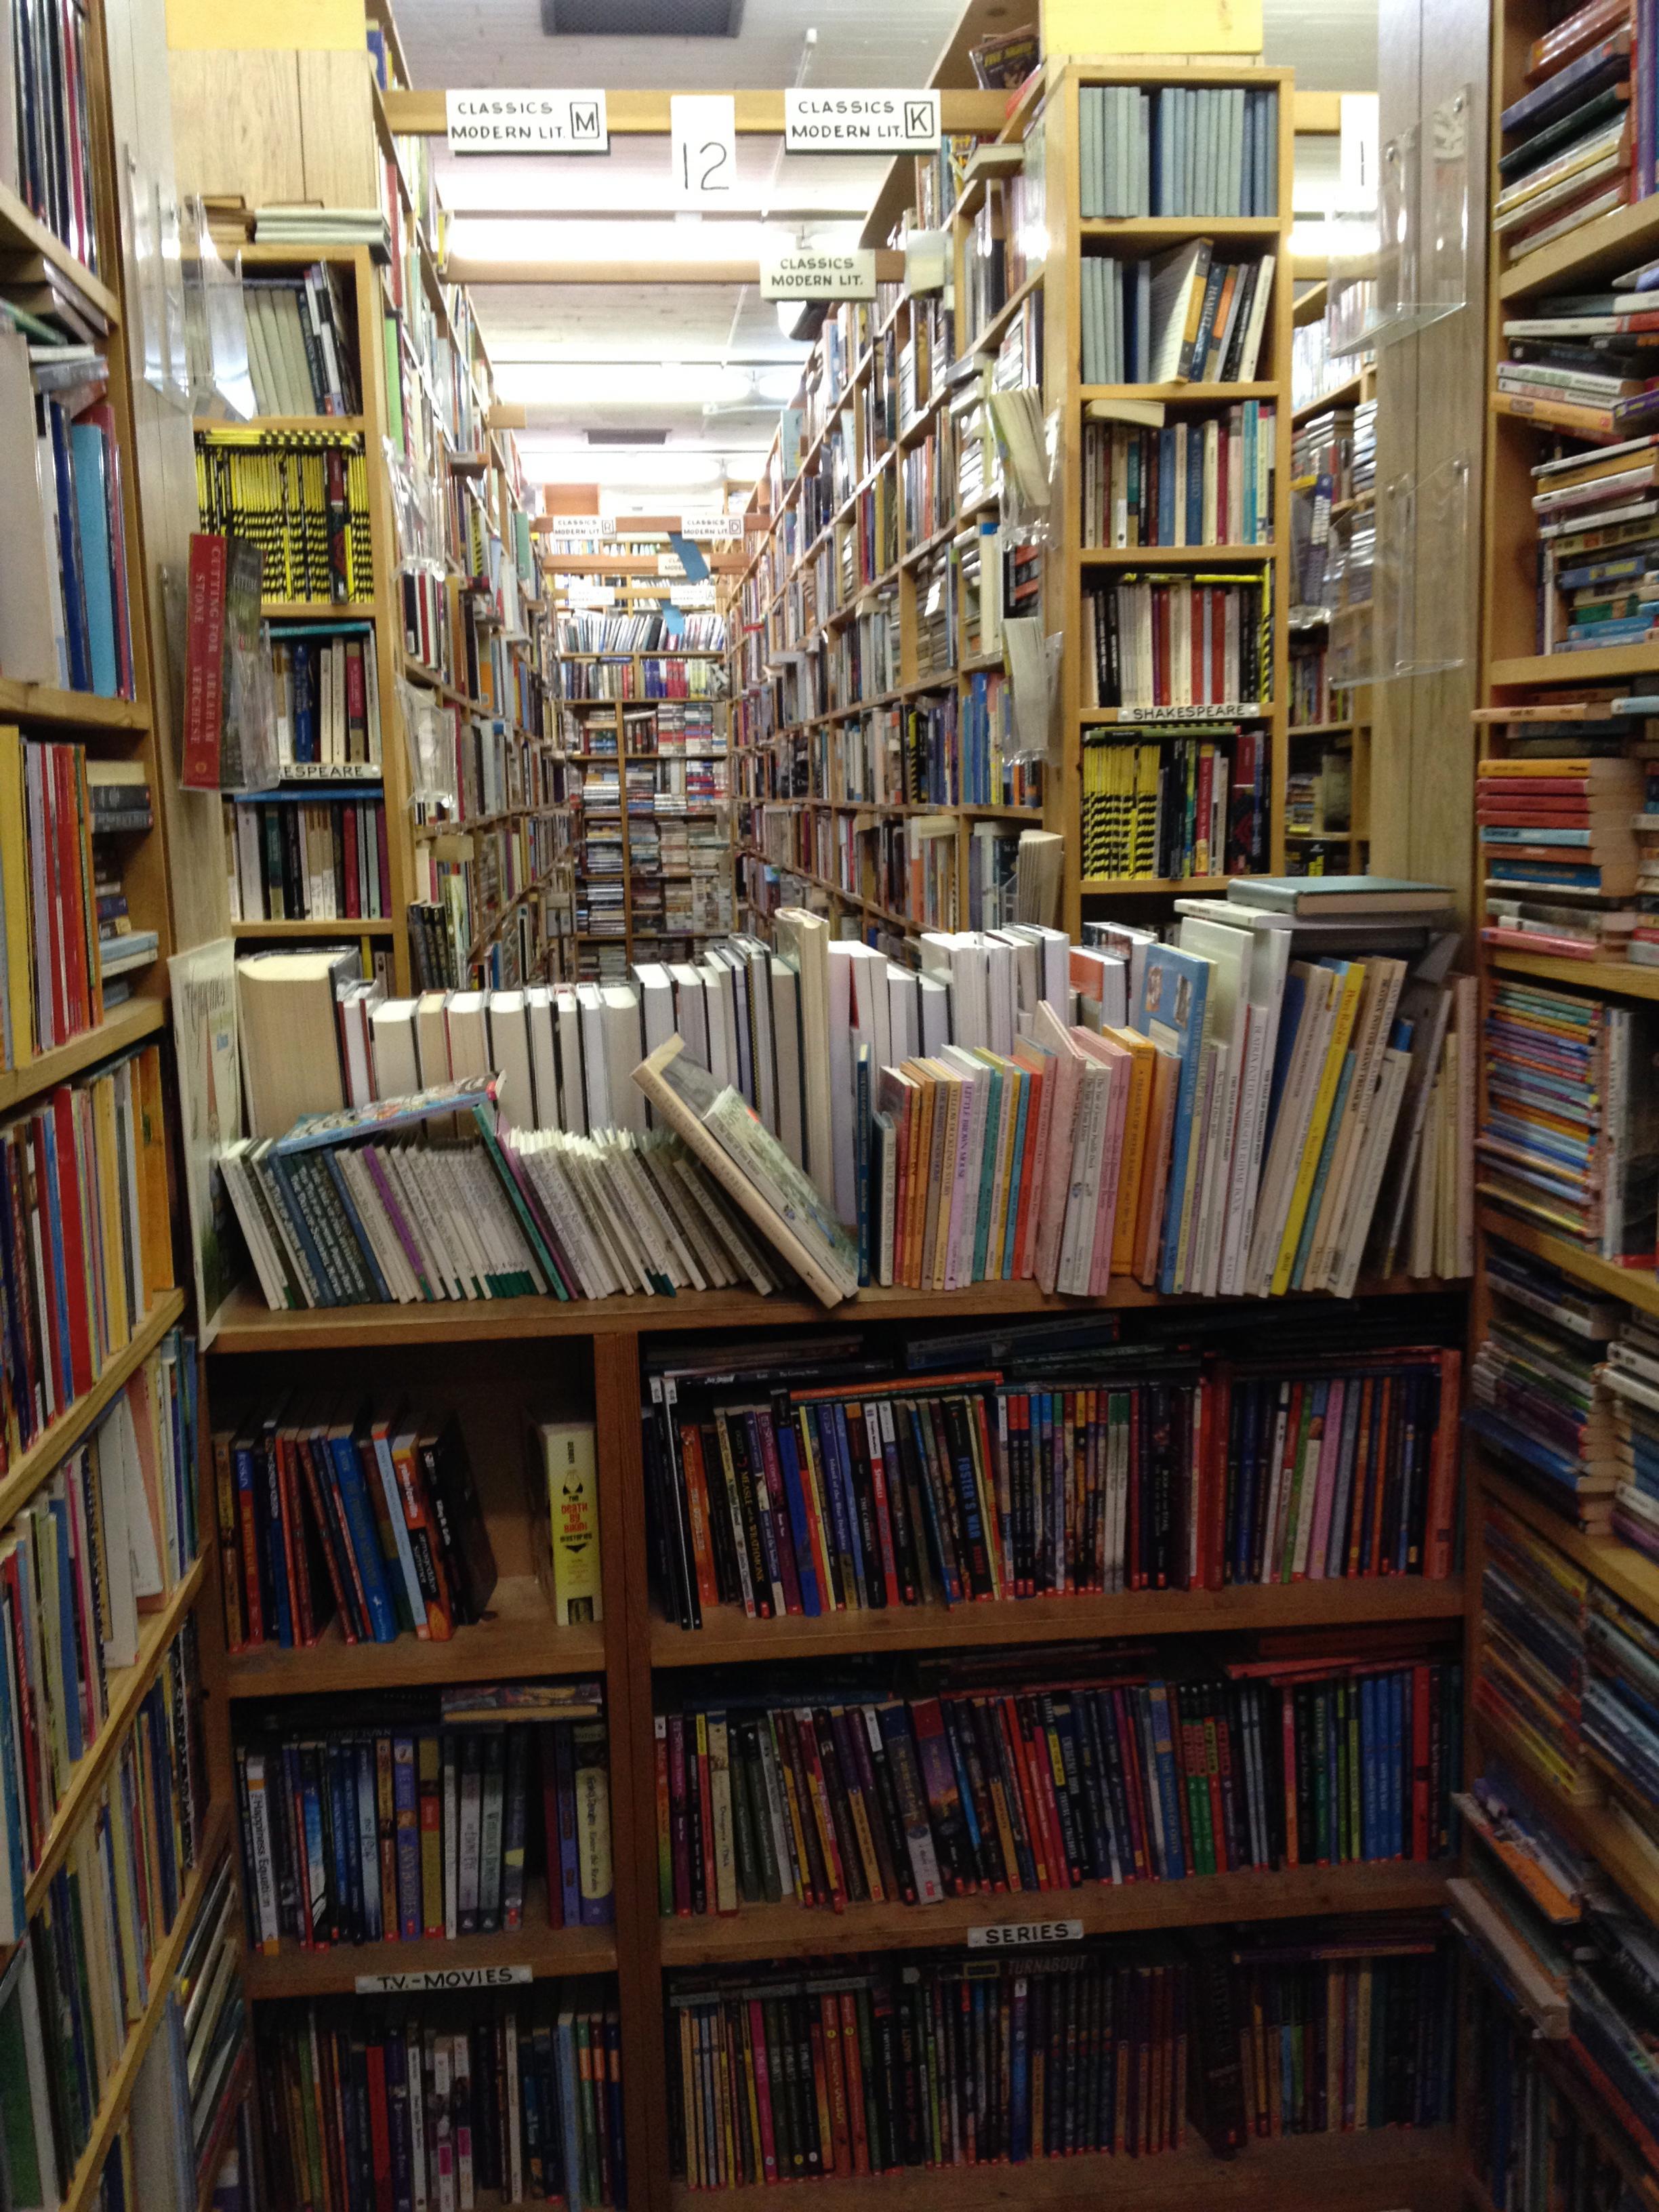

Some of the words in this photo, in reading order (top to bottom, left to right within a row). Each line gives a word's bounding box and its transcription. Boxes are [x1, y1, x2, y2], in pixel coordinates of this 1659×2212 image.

[458, 102, 553, 115] CLASSICS
[792, 125, 870, 138] MODERN
[878, 125, 903, 138] LIT.
[911, 106, 928, 132] K
[798, 101, 895, 114] CLASSICS
[451, 126, 531, 139] MODERN
[539, 126, 565, 139] LIT.
[575, 111, 595, 131] M
[682, 142, 729, 190] 12
[780, 258, 855, 270] CLASSICS
[771, 274, 832, 286] MODERN
[839, 274, 863, 286] LIT.
[209, 546, 220, 617] CUTTING
[194, 572, 205, 625] STONE
[207, 623, 219, 653] FOR
[205, 672, 217, 743] ABRAHAM
[1132, 704, 1246, 720] SHAKESPEARE
[1248, 1025, 1263, 1063] BEATRIX
[1132, 1078, 1143, 1118] TREASURY
[1244, 1065, 1259, 1105] POTTER'S
[962, 1086, 972, 1118] LITTLE
[959, 1120, 969, 1150] BROWN
[1132, 1120, 1141, 1130] OF
[1240, 1109, 1254, 1150] NURSERY
[1128, 1133, 1139, 1157] PETER
[886, 1161, 894, 1181] TALE
[958, 1152, 966, 1178] MOUSE
[1126, 1159, 1136, 1187] RABBIT
[1237, 1153, 1249, 1185] RHYME
[886, 1183, 893, 1193] OF
[1232, 1187, 1245, 1215] BOOK
[884, 1197, 893, 1242] BENJAMIN
[884, 1244, 893, 1273] BUNNY
[829, 1458, 837, 1479] Island
[398, 1463, 419, 1518] yolen/coville
[740, 1470, 754, 1507] MEASLE
[832, 1490, 840, 1500] the
[874, 1468, 884, 1499] SPINELLI
[956, 1456, 978, 1510] FOSTER'S
[967, 1513, 981, 1539] WAR
[561, 1502, 588, 1515] DEATH
[570, 1514, 580, 1523] BY
[834, 1502, 843, 1517] Blue
[859, 1497, 868, 1511] THE
[564, 1523, 588, 1534] BIKINI
[836, 1519, 848, 1551] Dolphins
[861, 1513, 872, 1551] CARIBBEAN
[418, 1533, 438, 1593] armageddon
[251, 1800, 266, 1856] Happiness
[985, 1923, 1069, 1944] SERIES
[377, 1967, 513, 1992] T.V.-MOVIES
